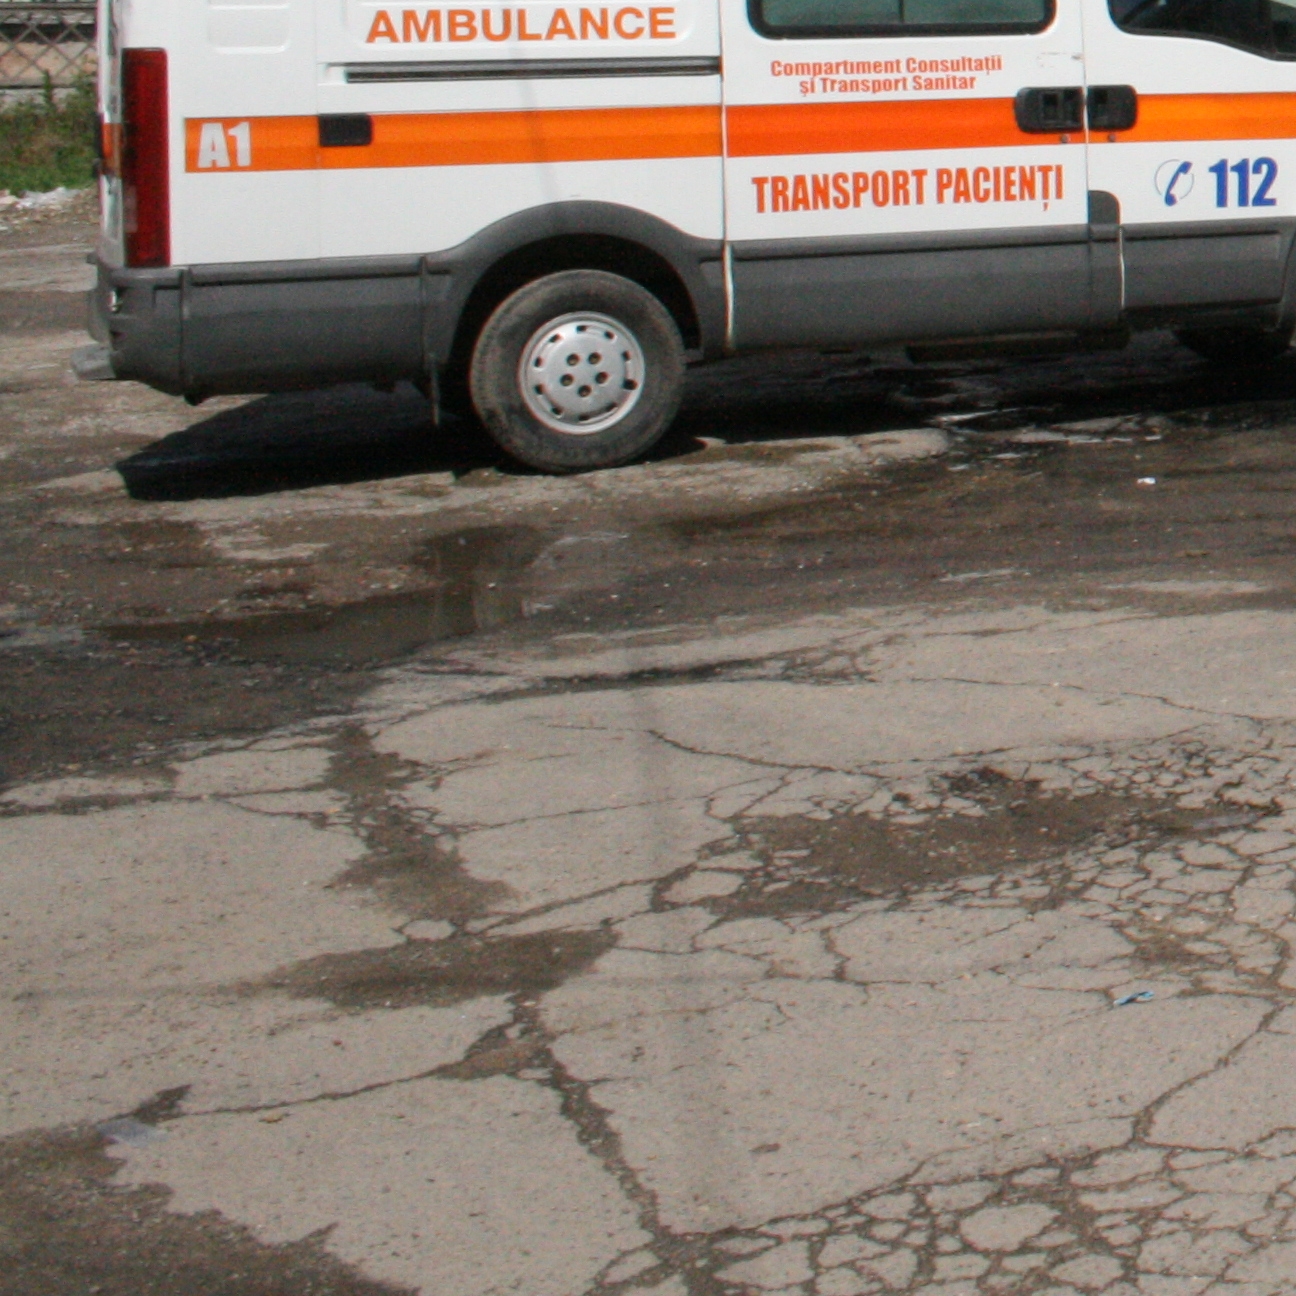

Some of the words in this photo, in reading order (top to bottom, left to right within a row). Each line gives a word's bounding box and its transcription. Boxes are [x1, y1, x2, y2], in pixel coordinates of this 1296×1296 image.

[366, 6, 676, 44] AMBULANCE
[770, 58, 901, 78] Compartiment
[820, 76, 908, 94] Transport
[912, 74, 977, 91] Sanitar
[197, 122, 252, 169] A1
[752, 168, 928, 213] TRANSPORT
[1208, 157, 1278, 208] 112
